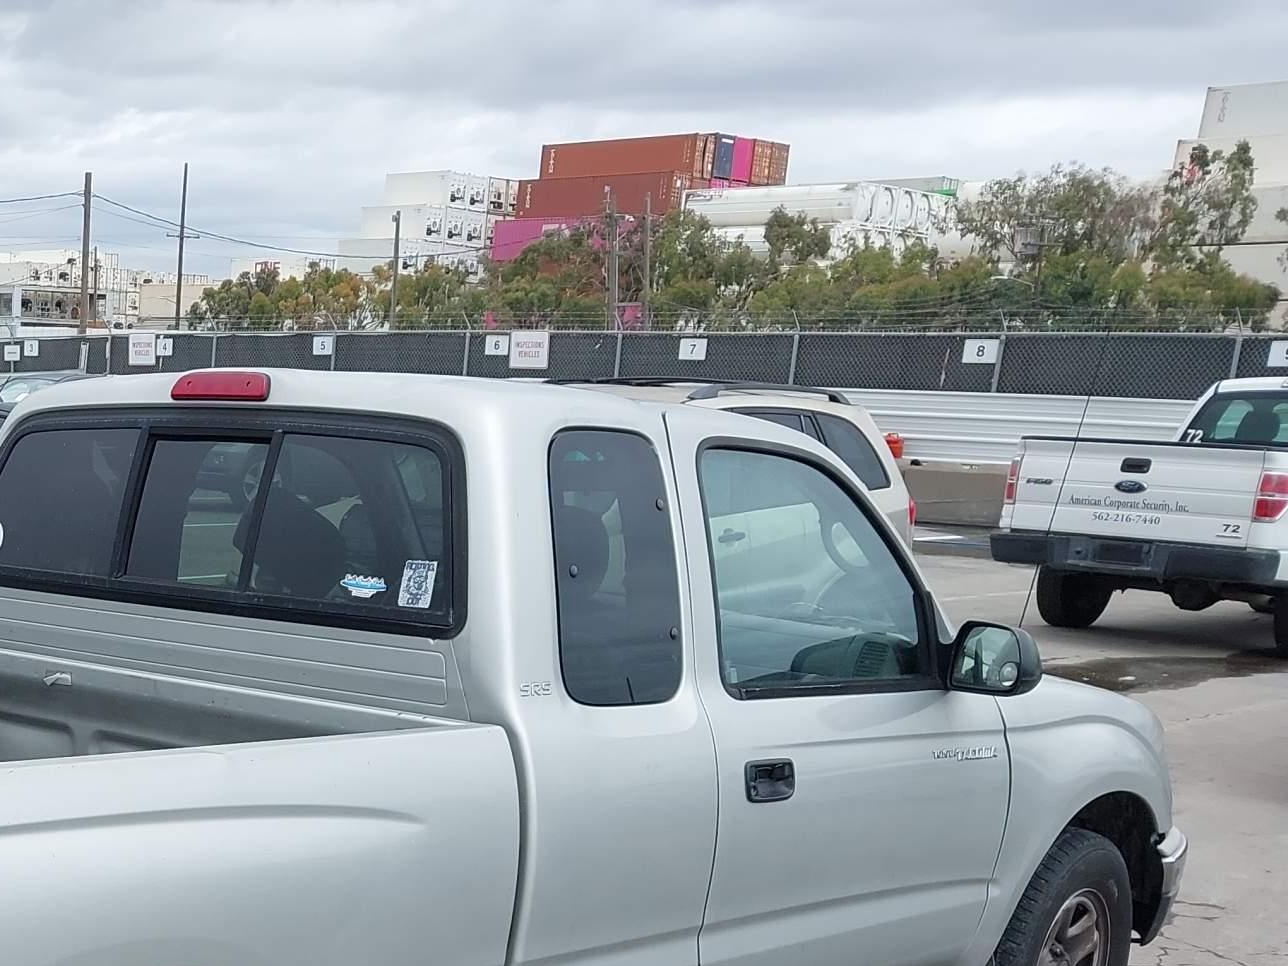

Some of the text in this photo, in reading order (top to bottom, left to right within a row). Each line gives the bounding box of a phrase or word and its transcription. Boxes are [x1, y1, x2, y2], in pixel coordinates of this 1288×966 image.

[162, 342, 168, 353] 4
[320, 340, 326, 350] 5
[494, 340, 500, 350] 6
[689, 344, 697, 354] 7
[976, 345, 985, 357] 8
[1186, 429, 1204, 443] 72
[1069, 494, 1102, 507] American
[1104, 496, 1139, 510] Corporate
[1175, 501, 1190, 513] Inc.
[1092, 512, 1161, 525] 562-216-7440
[1222, 524, 1241, 533] 72
